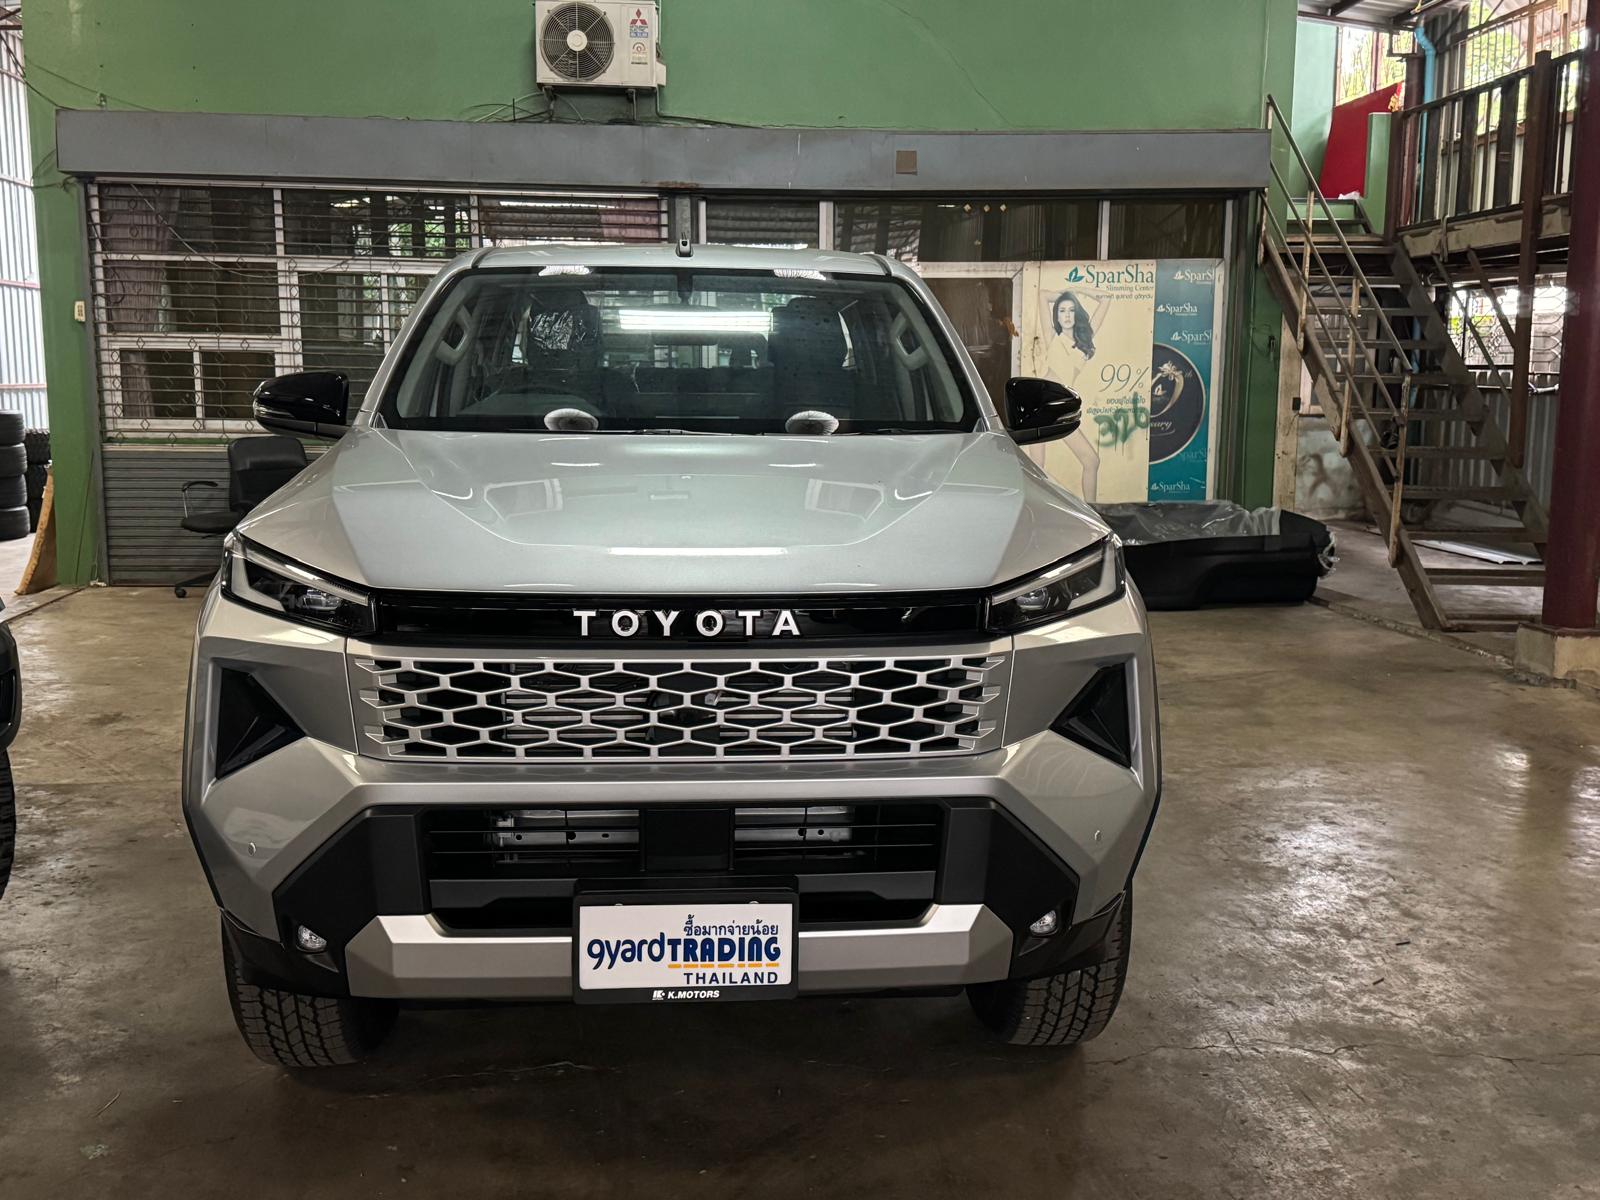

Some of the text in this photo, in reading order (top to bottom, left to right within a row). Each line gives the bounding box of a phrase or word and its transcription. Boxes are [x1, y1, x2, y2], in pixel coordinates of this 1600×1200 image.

[1085, 263, 1154, 288] SparSha
[1185, 269, 1215, 283] SparS
[1166, 302, 1198, 315] SparSha
[1182, 330, 1212, 344] SparS
[1099, 363, 1150, 393] 99%
[1159, 480, 1191, 492] SparSha
[573, 609, 801, 637] TOYOTA
[683, 914, 779, 937] ซื้อมากจ่ายน้อย
[684, 971, 778, 985] THAILAND
[667, 990, 720, 999] K.MOTORS
